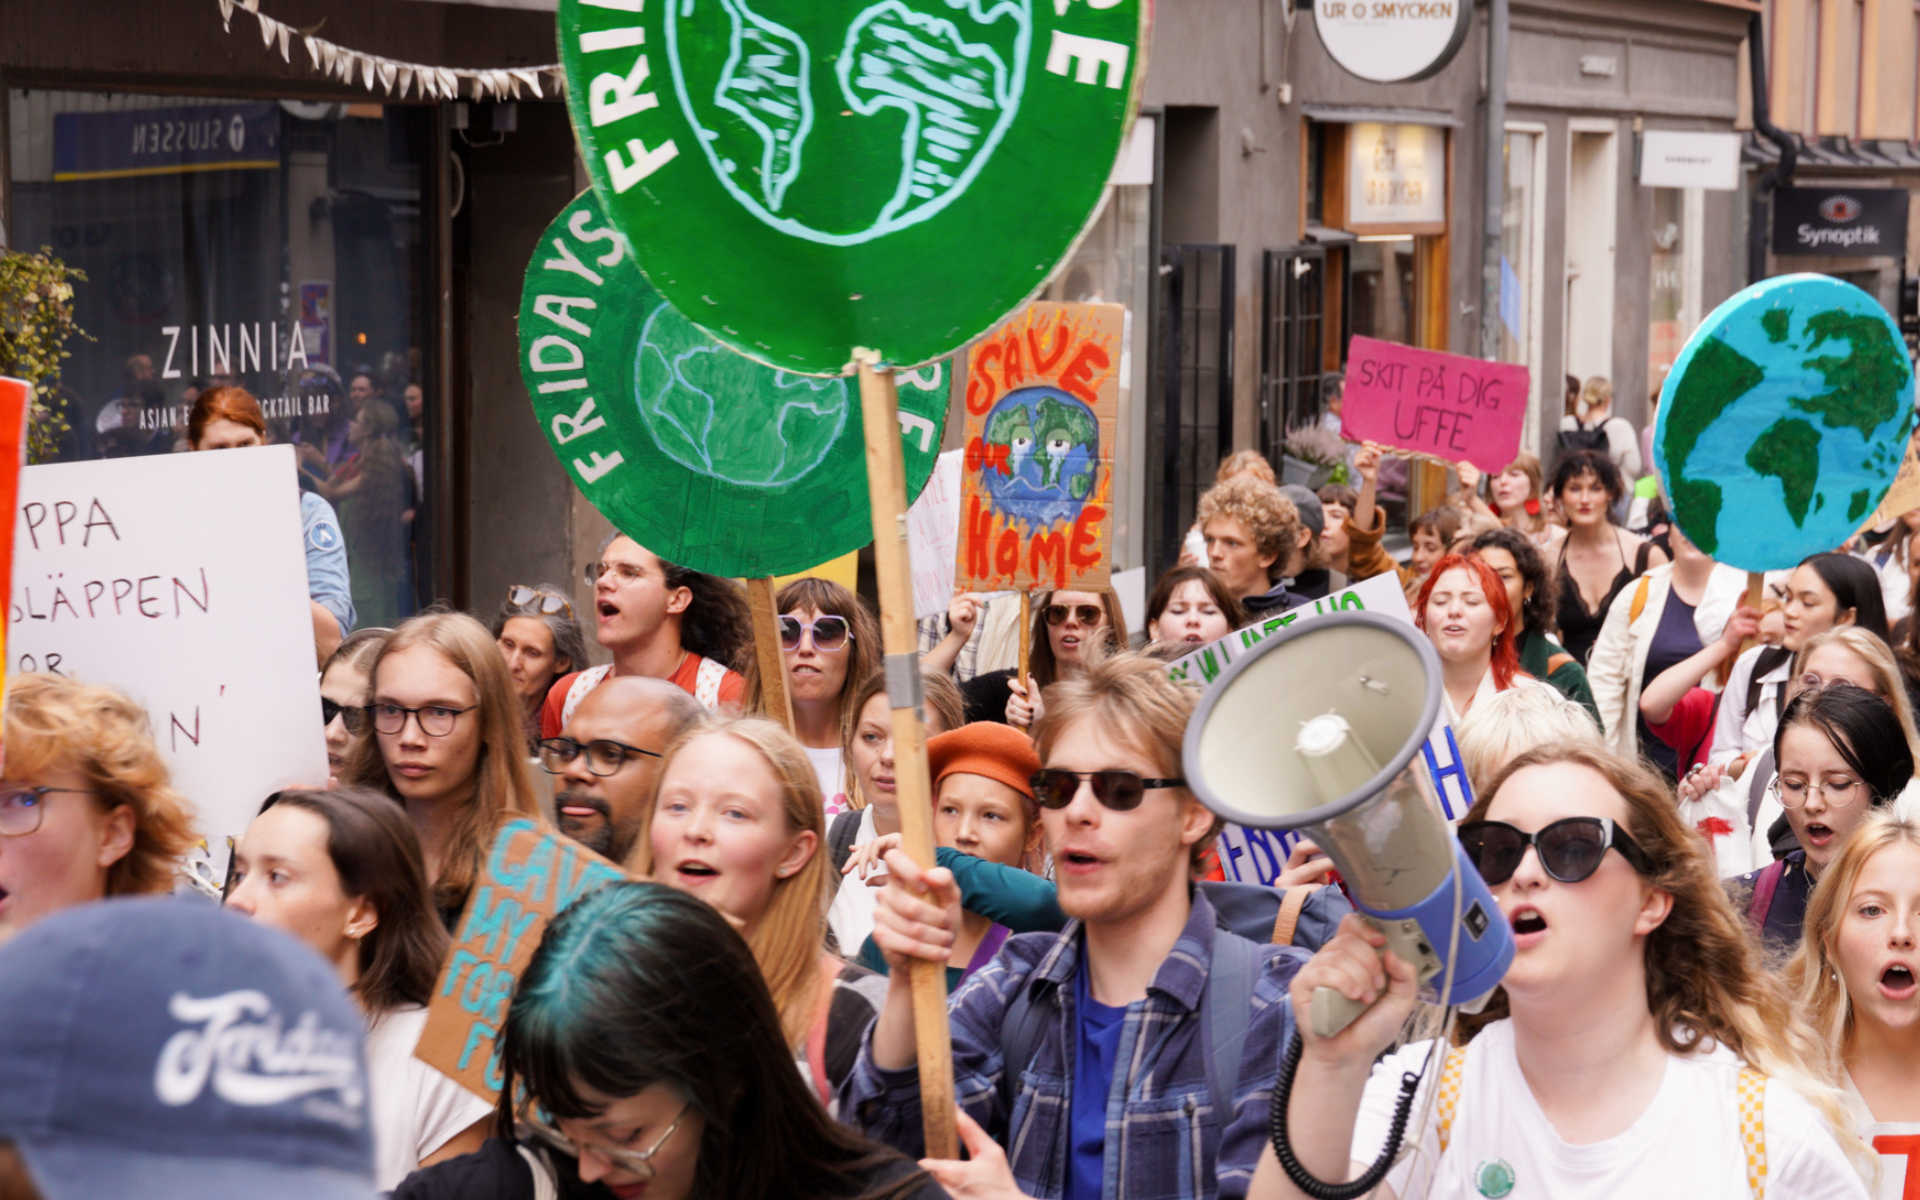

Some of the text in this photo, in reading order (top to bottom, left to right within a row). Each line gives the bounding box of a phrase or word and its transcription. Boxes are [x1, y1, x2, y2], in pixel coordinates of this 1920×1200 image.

[1323, 2, 1346, 19] UR
[578, 0, 680, 193] FRI
[1797, 223, 1880, 248] Synoptik
[161, 319, 308, 379] ZINNIA
[528, 209, 625, 484] FRIDAYS
[966, 325, 1110, 416] SAVE
[139, 407, 177, 430] ASIAN
[308, 393, 330, 416] BAR
[1360, 359, 1503, 410] SKIT PÅ DIG
[1394, 399, 1472, 452] UFFE
[967, 436, 1012, 476] OUR
[967, 494, 1107, 590] HOME
[462, 886, 539, 965] MY
